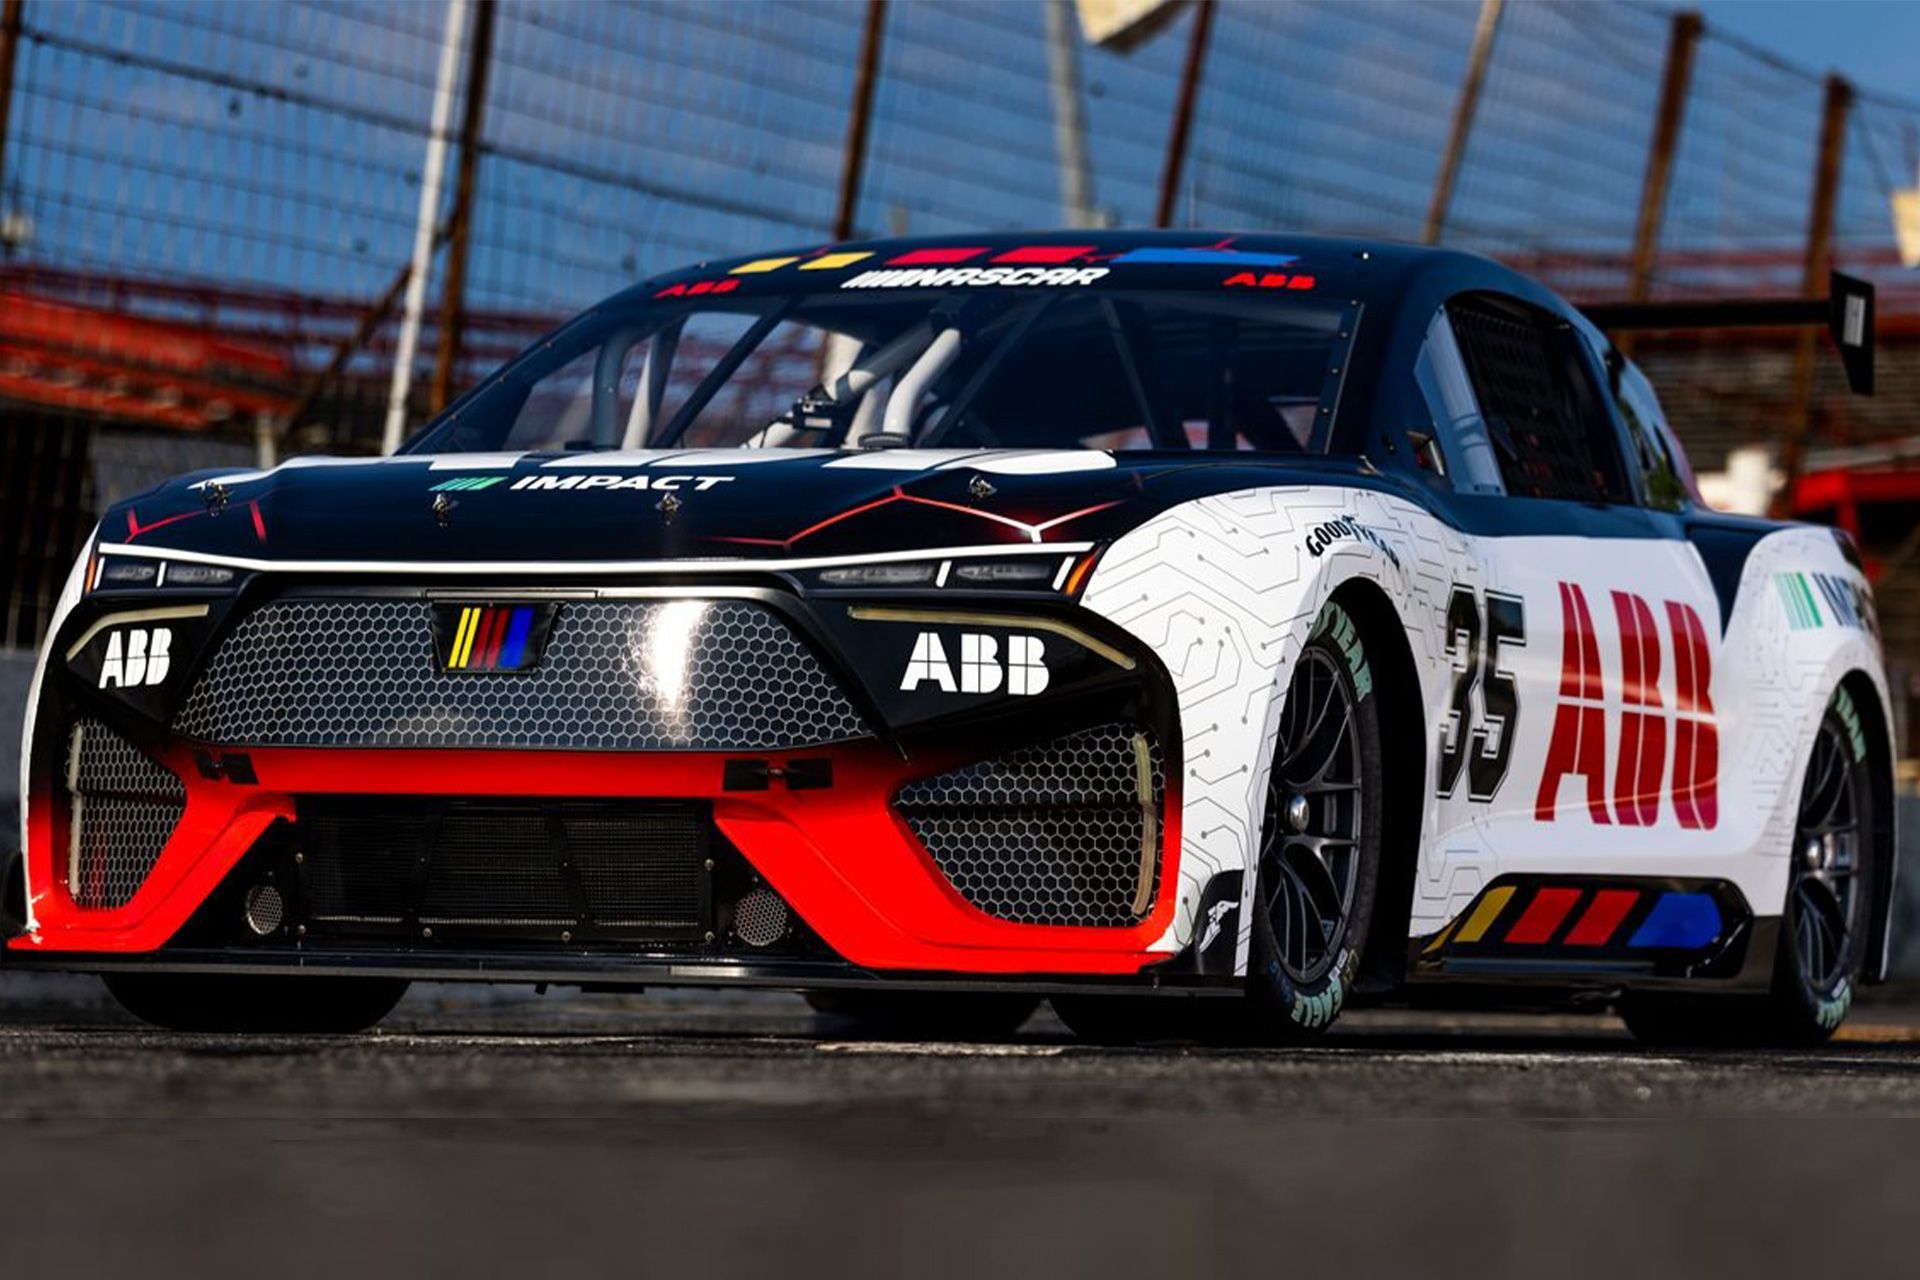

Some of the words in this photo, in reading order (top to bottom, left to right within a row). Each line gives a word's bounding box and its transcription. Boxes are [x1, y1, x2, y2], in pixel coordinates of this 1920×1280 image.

[655, 278, 741, 299] ABB
[900, 267, 1110, 288] NASCAR
[1221, 271, 1316, 290] ABB
[510, 476, 736, 490] IMPACT
[98, 628, 172, 689] ABB
[899, 632, 1050, 696] ABB
[1435, 582, 1527, 803] 35
[1534, 581, 1719, 830] ABB
